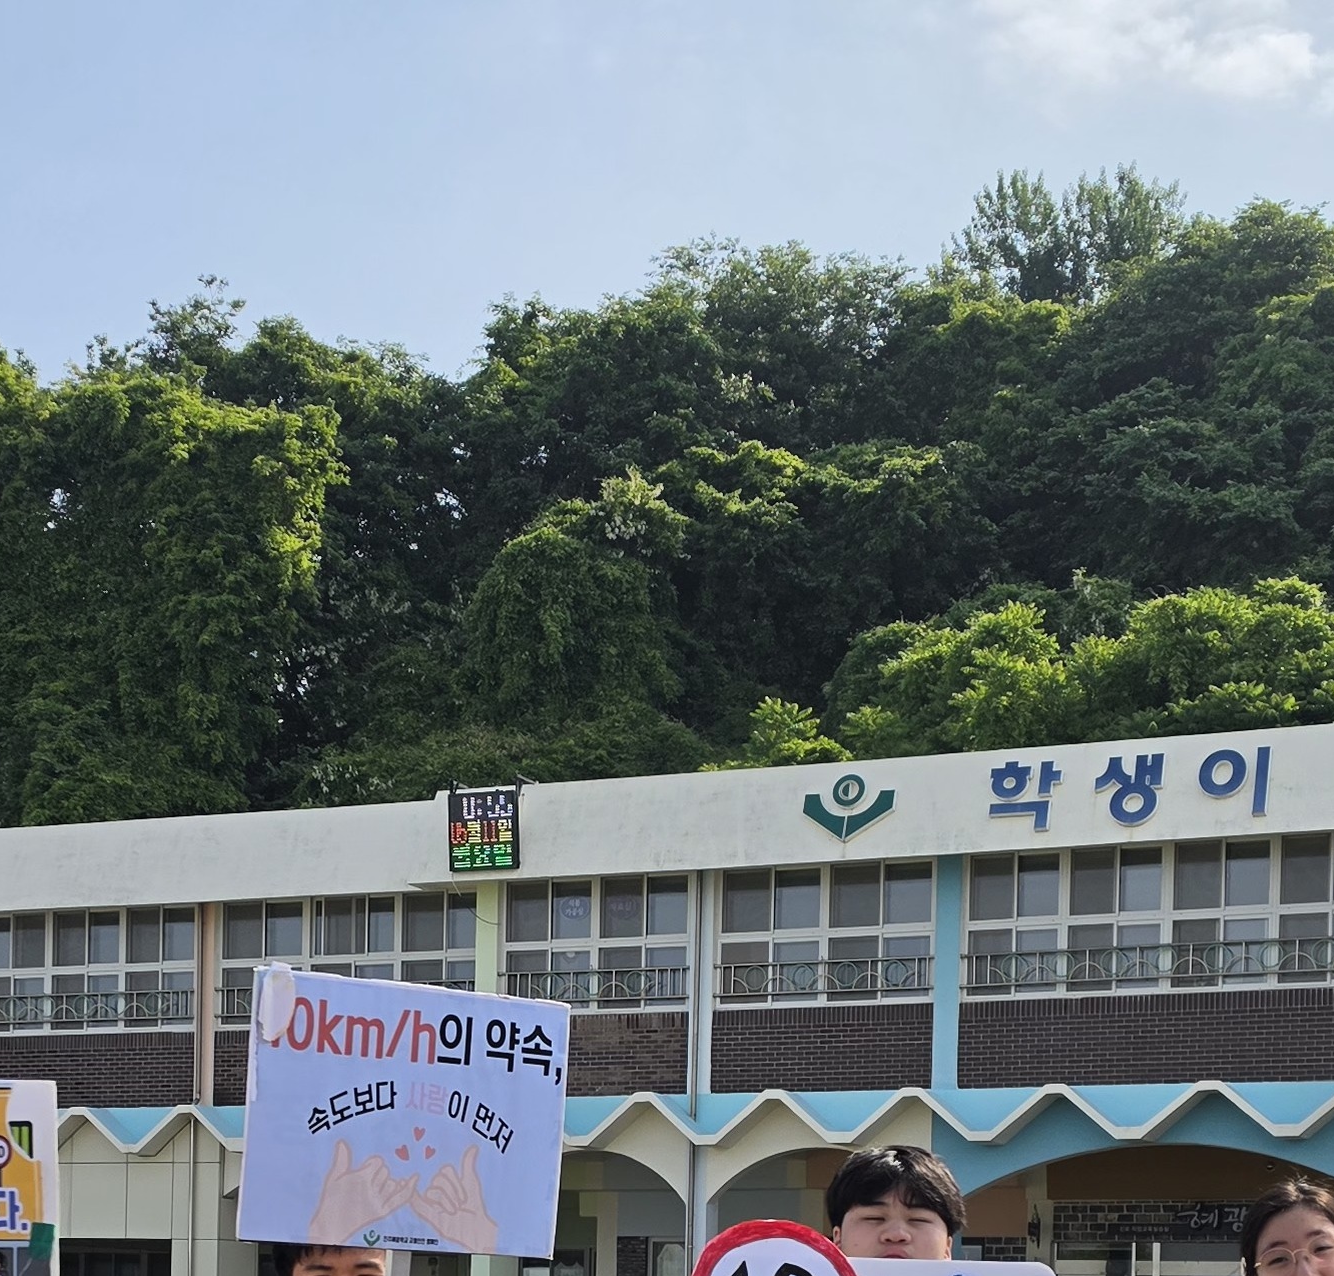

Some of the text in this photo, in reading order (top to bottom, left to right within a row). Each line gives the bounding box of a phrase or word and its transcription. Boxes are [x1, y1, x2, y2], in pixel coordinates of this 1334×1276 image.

[989, 746, 1272, 833] 학생이
[271, 996, 563, 1085] 0km/h의 약속,
[307, 1081, 514, 1154] 속도보다 사랑이 먼저
